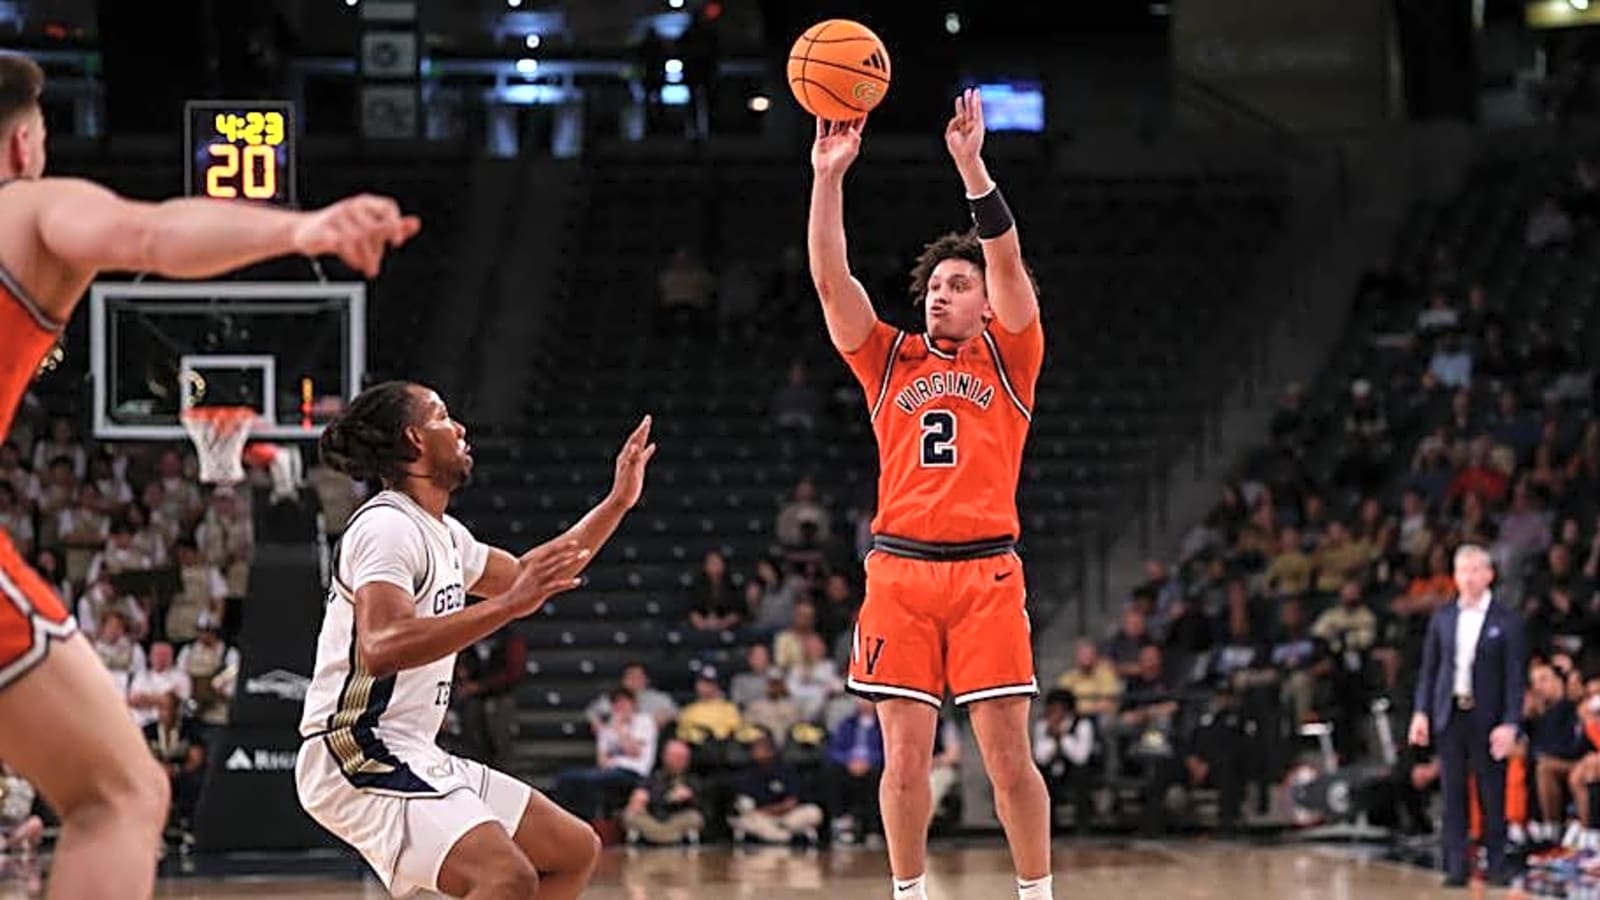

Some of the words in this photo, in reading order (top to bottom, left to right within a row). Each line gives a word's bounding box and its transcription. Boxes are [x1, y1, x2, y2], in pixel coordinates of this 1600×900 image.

[215, 112, 284, 145] 4:23
[207, 144, 276, 198] 20
[895, 371, 994, 414] VIRGINIA
[920, 409, 957, 467] 2
[866, 636, 885, 675] V
